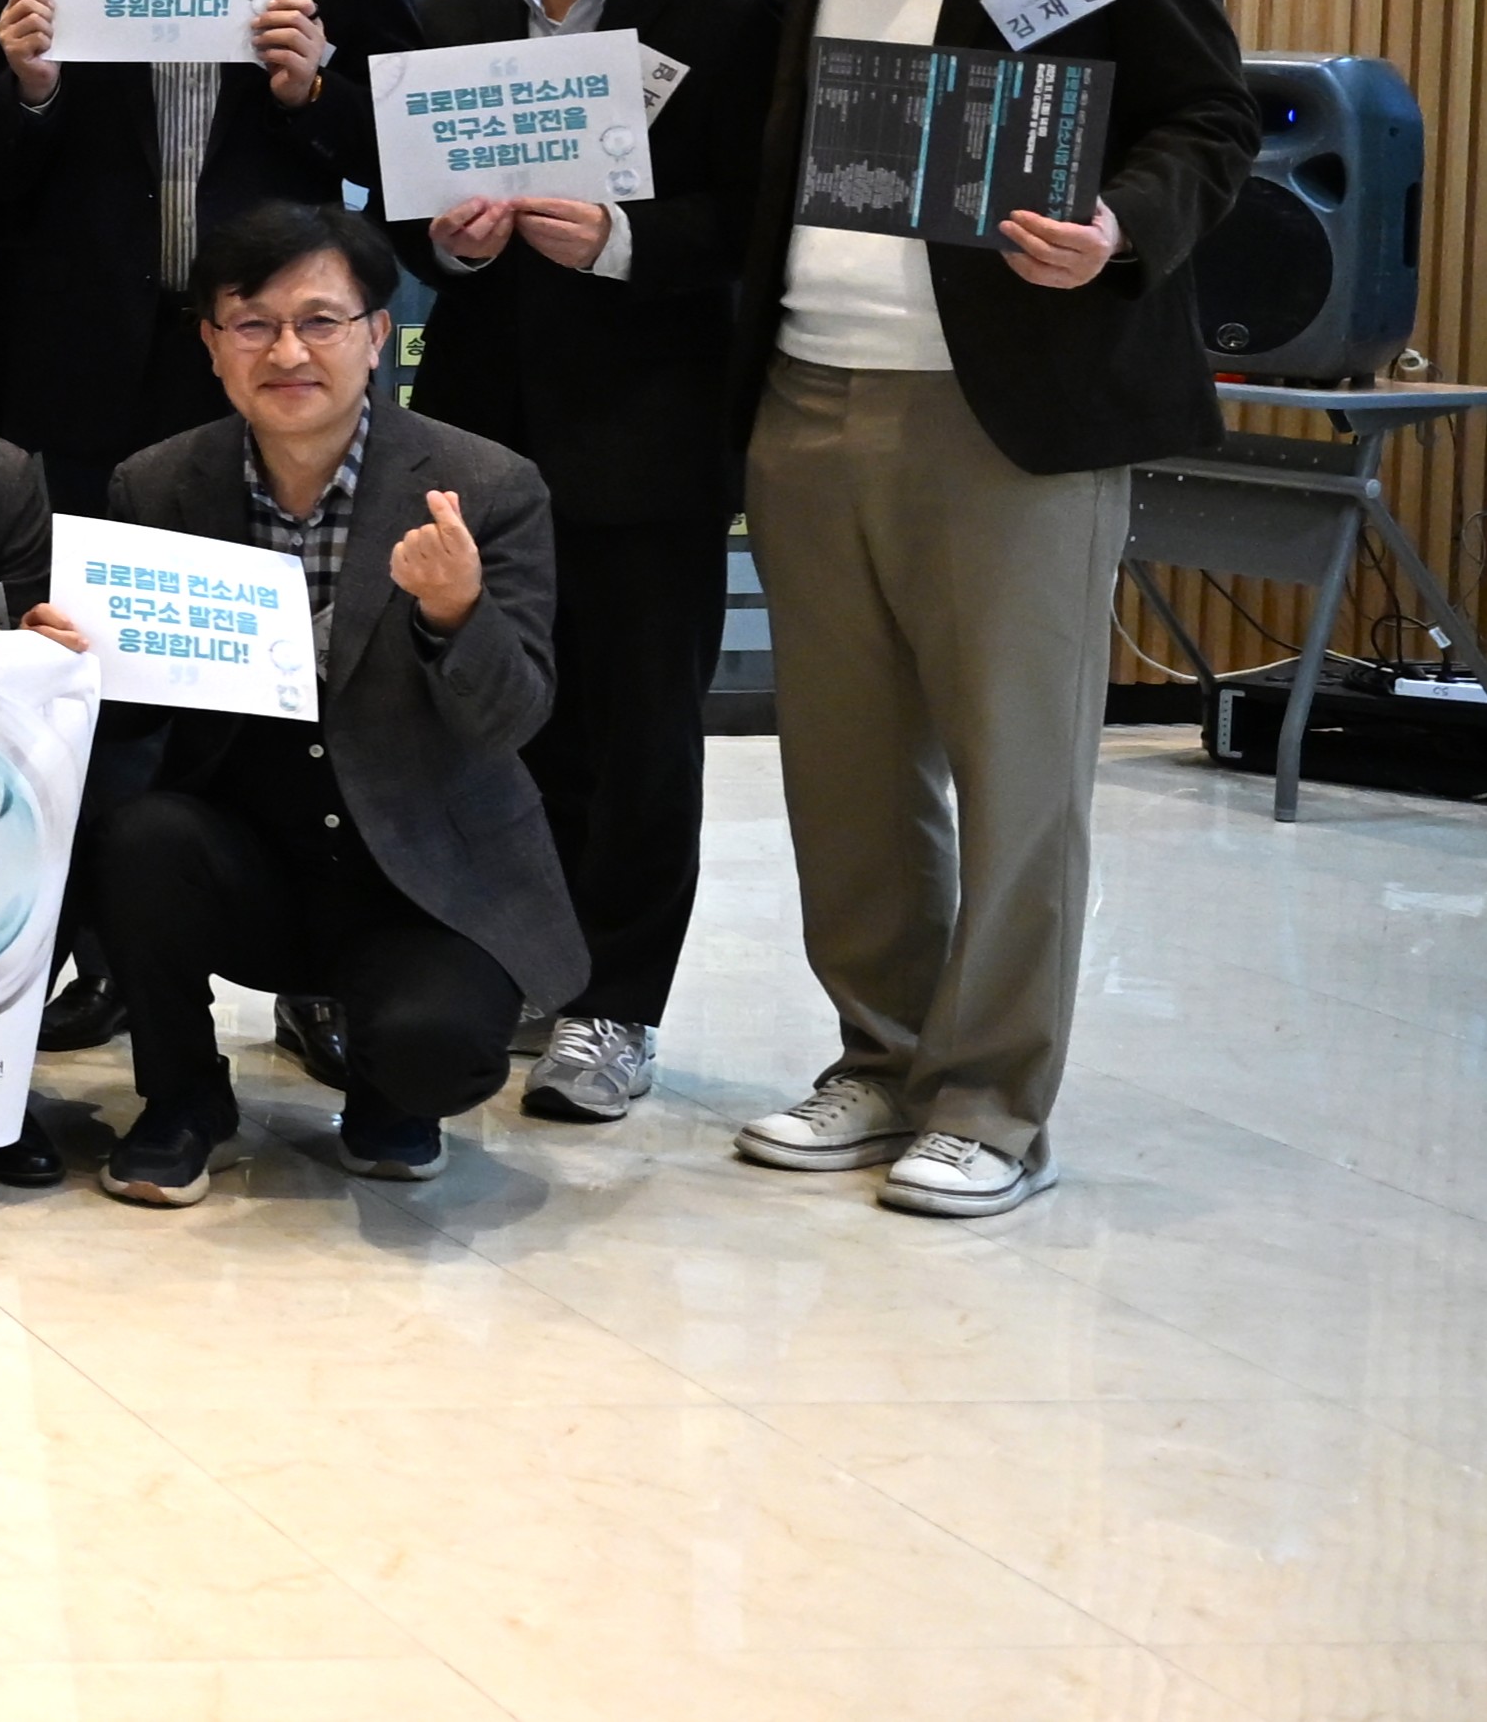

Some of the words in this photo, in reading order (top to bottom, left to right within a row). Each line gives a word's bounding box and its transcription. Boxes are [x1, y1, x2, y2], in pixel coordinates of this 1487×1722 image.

[405, 84, 505, 117] 글로컬랩
[508, 74, 610, 106] 컨소시엄
[431, 115, 509, 144] 연구소
[512, 106, 588, 136] 발전을
[447, 138, 579, 172] 응원합니다!
[84, 560, 181, 595] 글로컬랩
[187, 574, 280, 610] 컨소시엄
[108, 595, 182, 625] 연구소
[188, 604, 259, 636] 발전을
[117, 627, 250, 664] 응원합니다!
